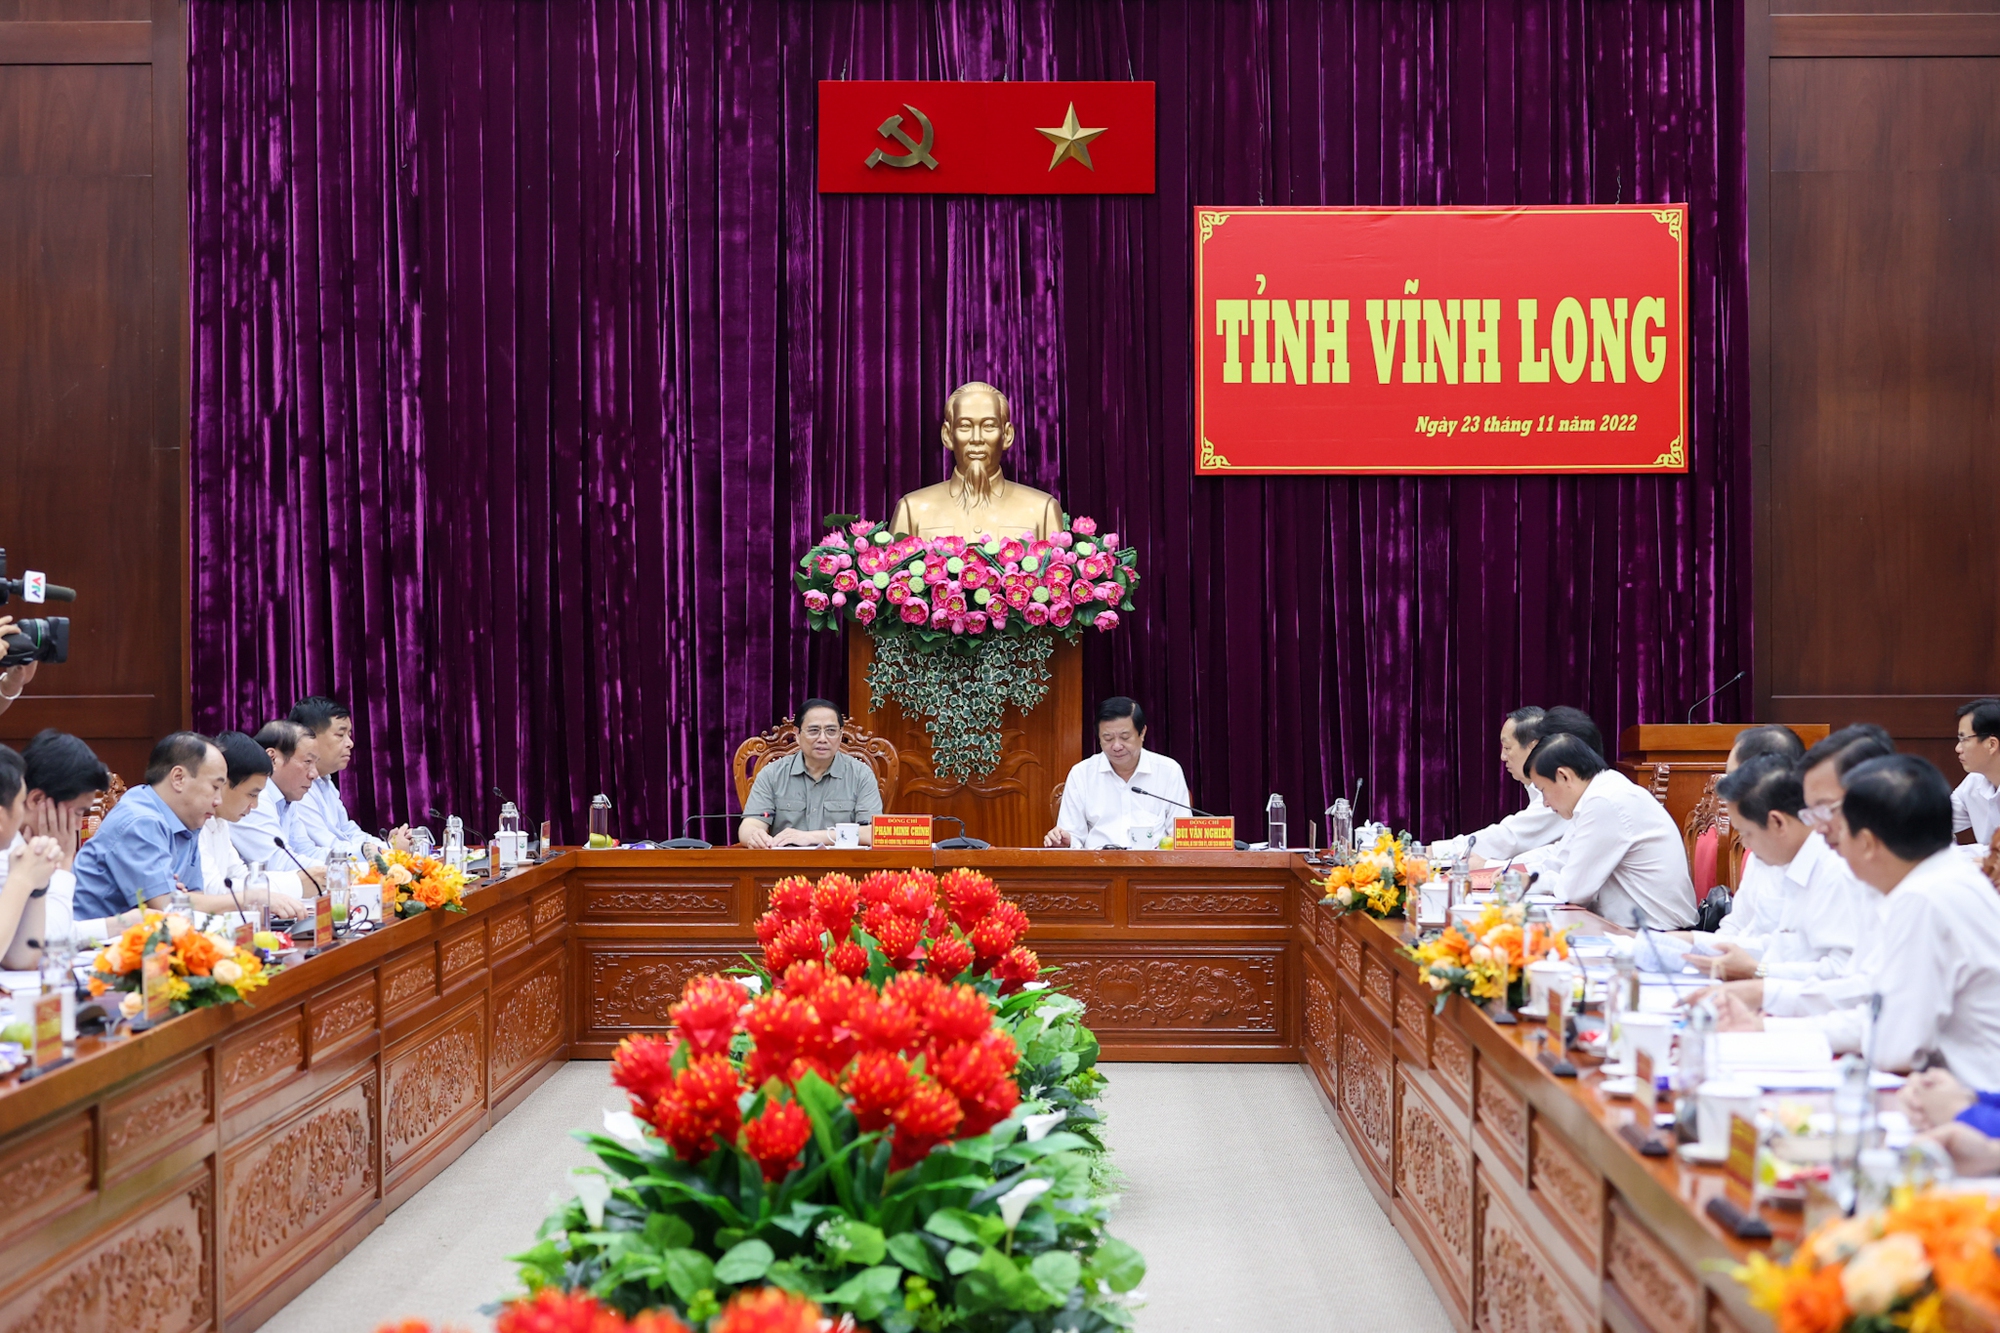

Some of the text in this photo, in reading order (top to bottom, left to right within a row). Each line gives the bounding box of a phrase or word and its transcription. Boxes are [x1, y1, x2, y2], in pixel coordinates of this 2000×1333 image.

[1215, 273, 1667, 385] TỈNH VĨNH LONG
[1414, 414, 1638, 437] Ngày 23 tháng 11 năm 2022
[874, 824, 930, 838] PHẠM MINH CHÍNH
[1176, 826, 1188, 839] BÙI
[1189, 826, 1203, 839] VĂN
